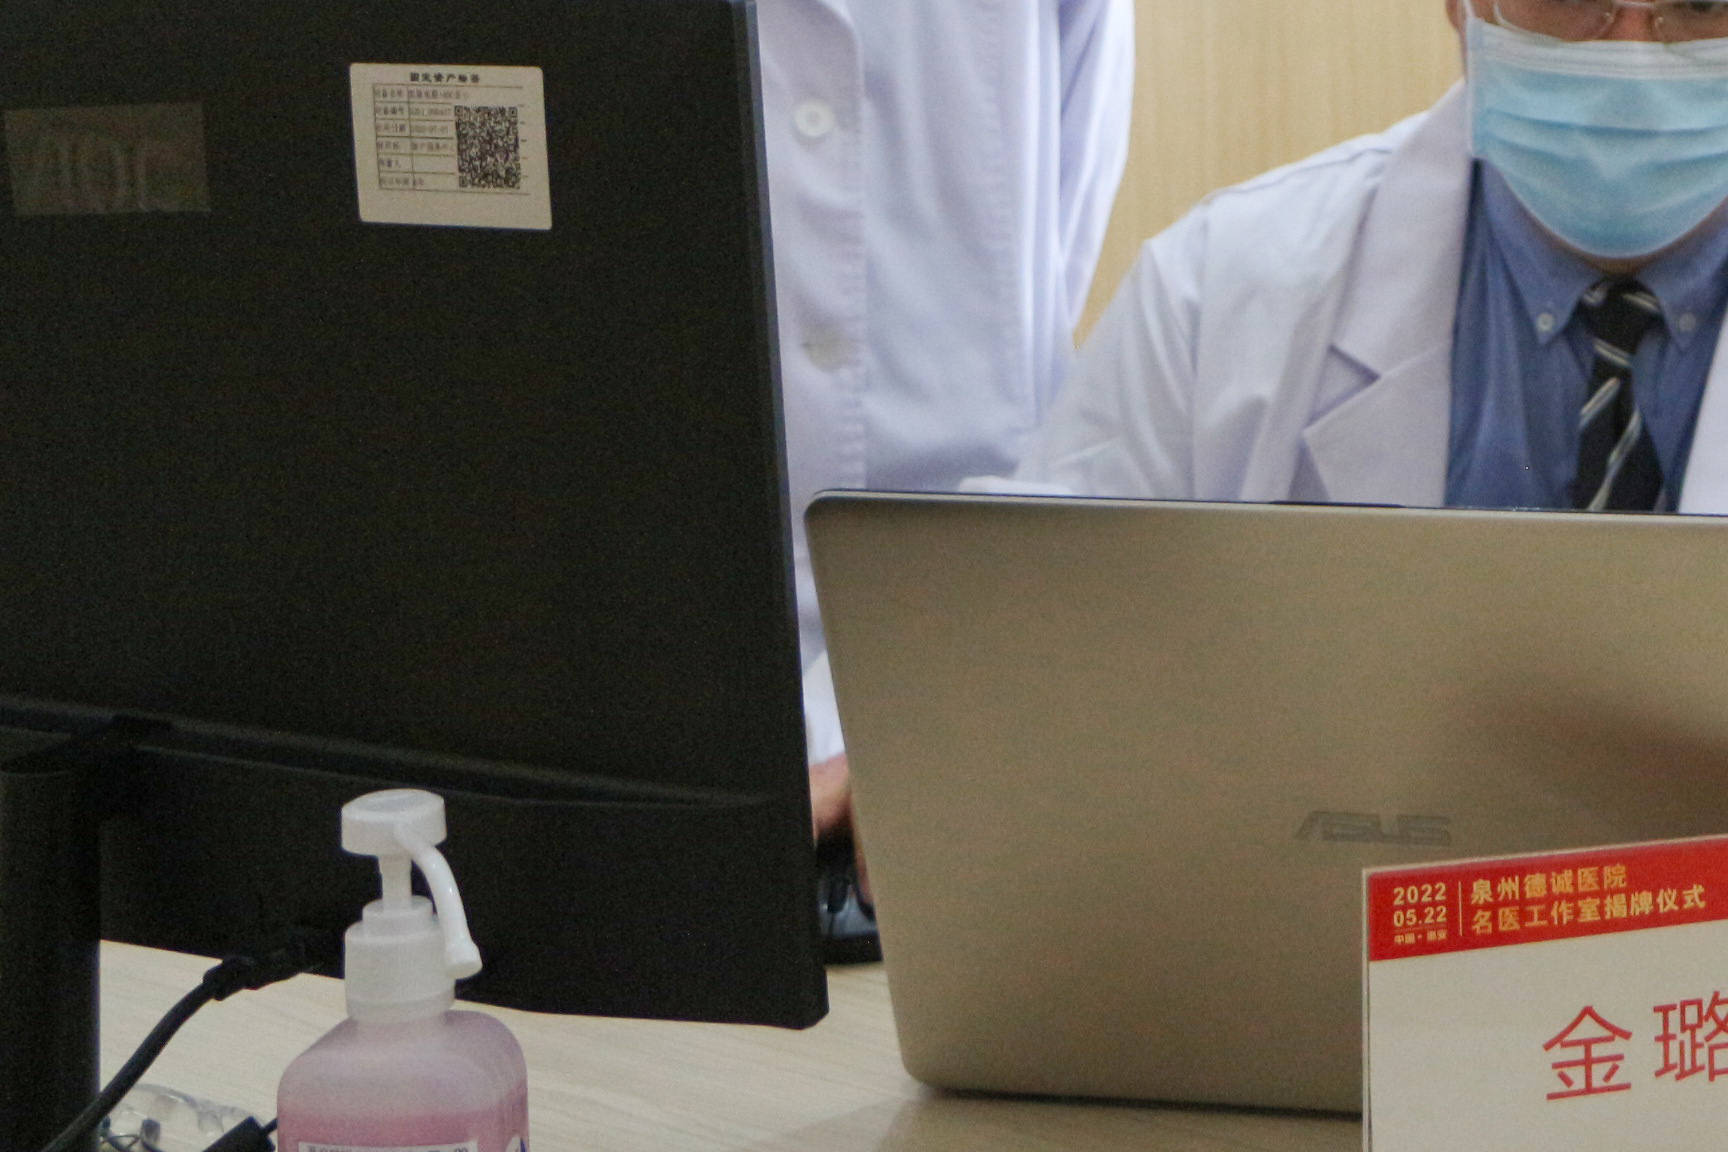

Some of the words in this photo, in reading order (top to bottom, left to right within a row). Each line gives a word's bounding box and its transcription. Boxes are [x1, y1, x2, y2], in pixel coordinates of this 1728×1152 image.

[1295, 811, 1451, 847] ASUS
[1393, 882, 1446, 906] 2022
[1471, 863, 1627, 904] 泉州德诚医院
[1393, 906, 1447, 927] 05.22
[1471, 884, 1706, 935] 名医工作室揭牌仪式
